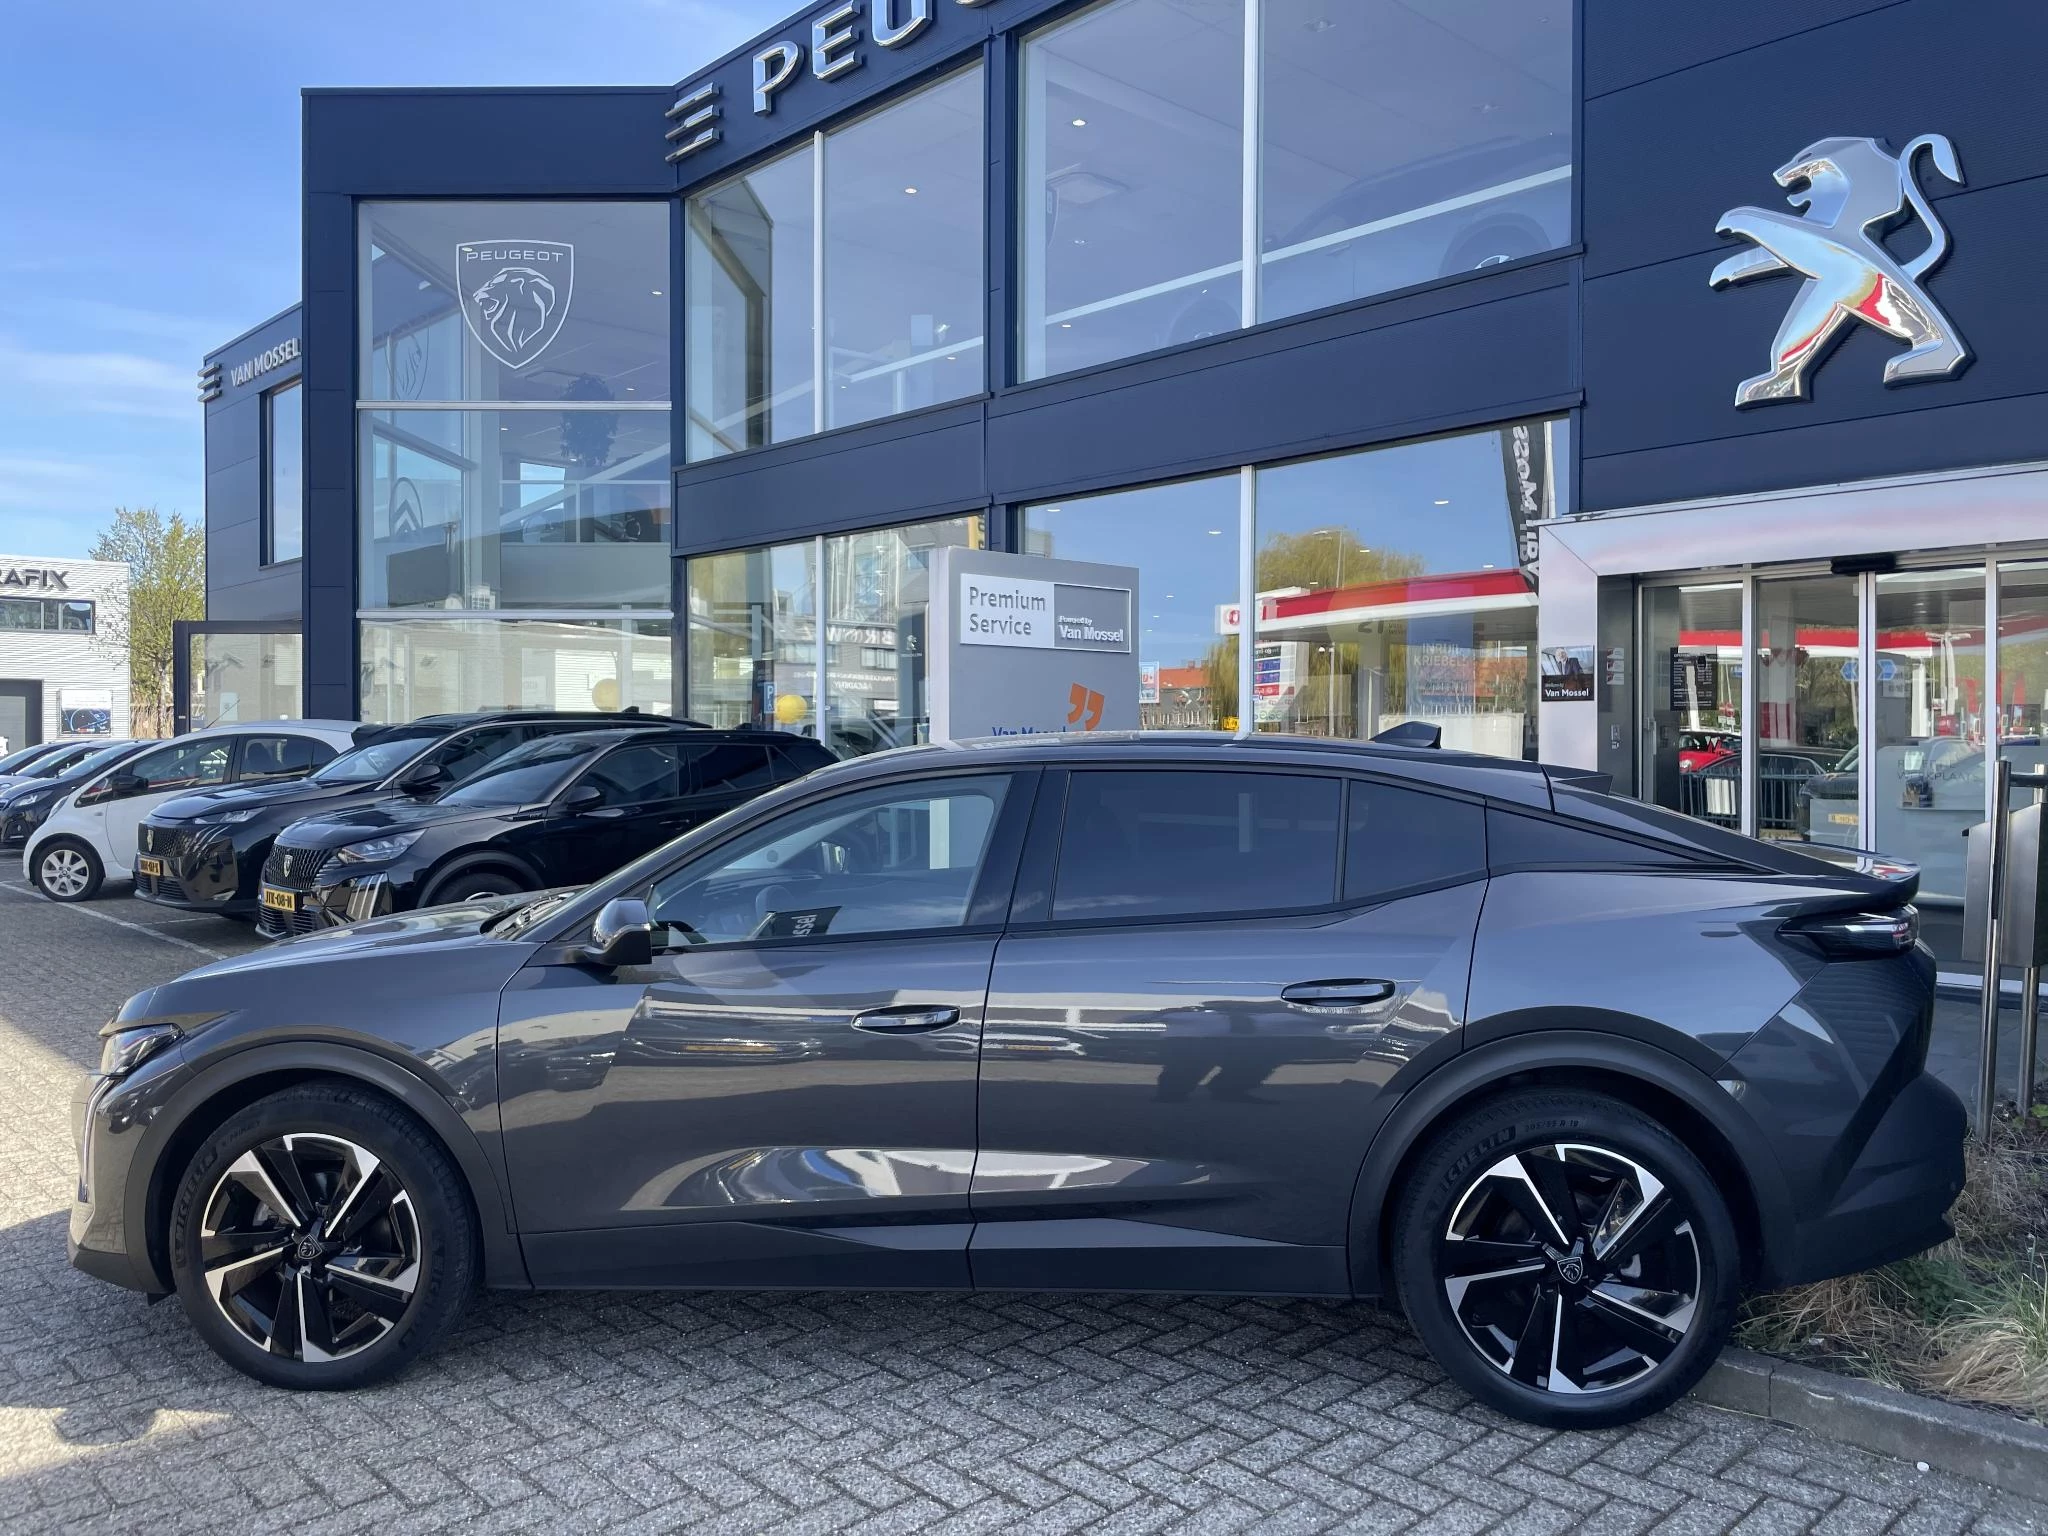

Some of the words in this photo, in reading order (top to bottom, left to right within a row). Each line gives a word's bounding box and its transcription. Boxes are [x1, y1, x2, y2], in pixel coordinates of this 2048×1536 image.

[752, 0, 998, 115] PEU
[466, 250, 563, 262] PEUGEOT
[231, 360, 254, 387] VAN
[254, 338, 301, 376] MOSSEL
[0, 568, 69, 590] AFIX
[969, 586, 1046, 611] Premium
[969, 613, 1032, 635] Service
[1059, 625, 1082, 640] Van
[1084, 626, 1124, 642] Mossel
[1545, 688, 1560, 697] Van
[1561, 687, 1589, 697] Mossel
[791, 914, 818, 938] ssel
